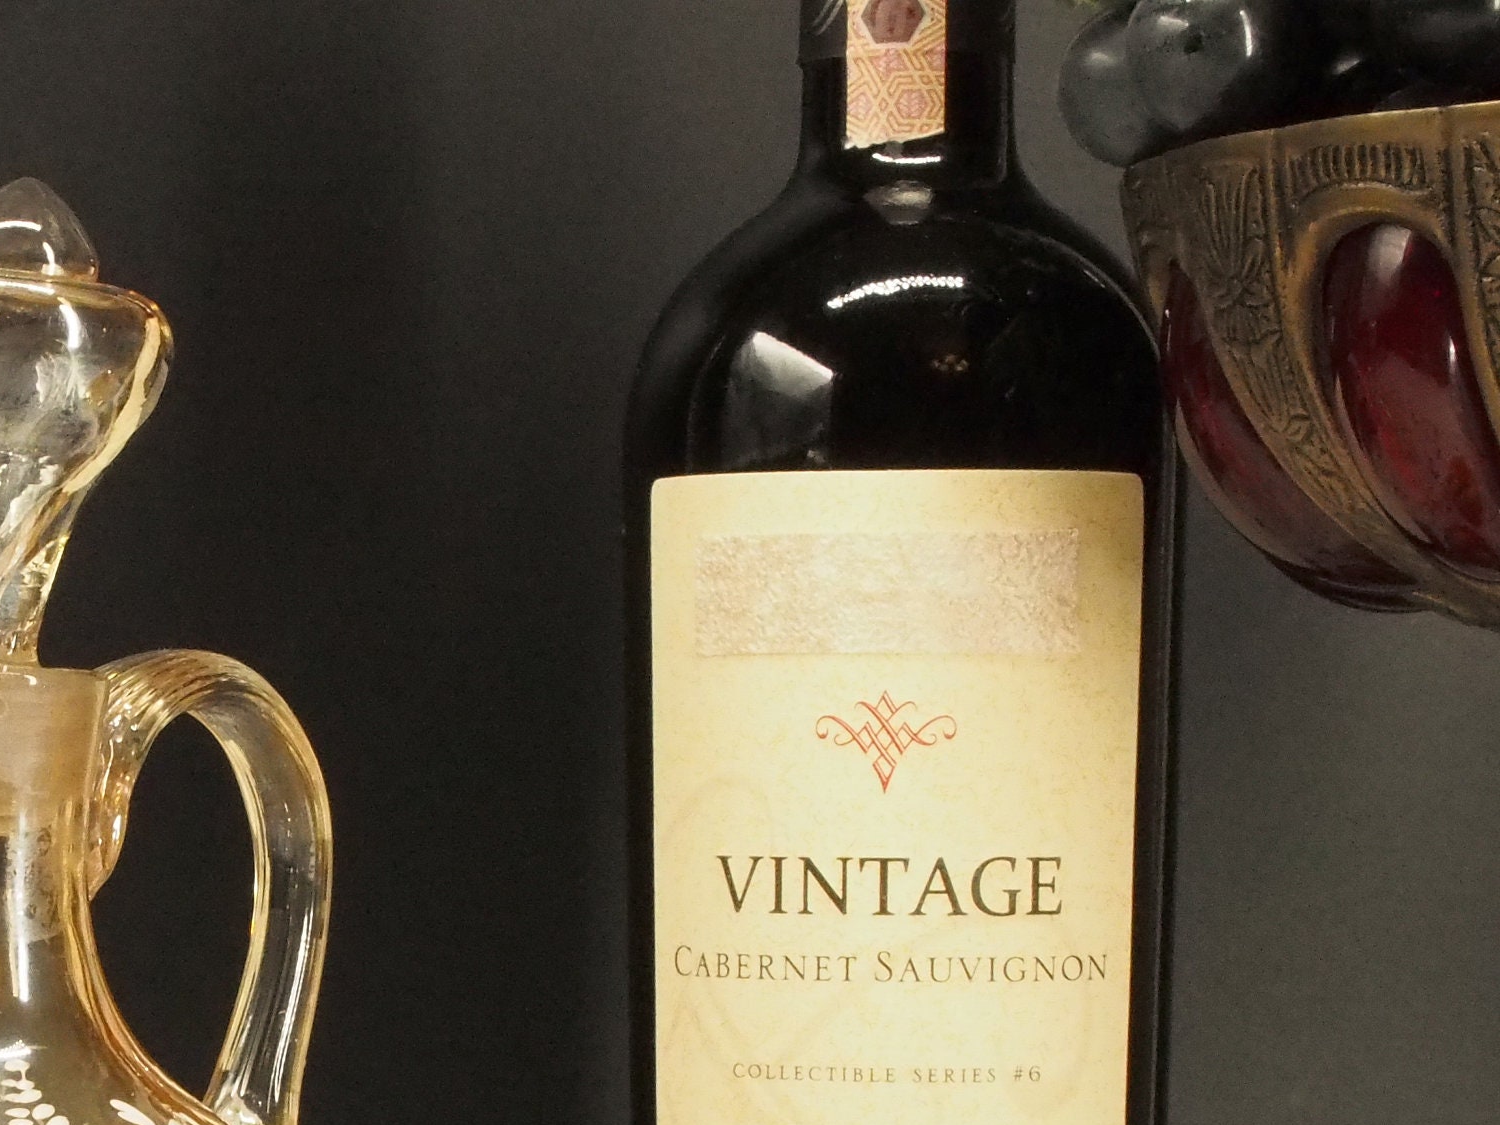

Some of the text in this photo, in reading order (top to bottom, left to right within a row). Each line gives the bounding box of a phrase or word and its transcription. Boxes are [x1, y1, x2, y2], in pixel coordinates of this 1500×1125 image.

[716, 855, 1063, 917] VINTAGE
[674, 945, 1108, 983] CABERNET SAUVIGNON
[732, 1062, 1042, 1083] COLLECTIBLE SERIES #6
